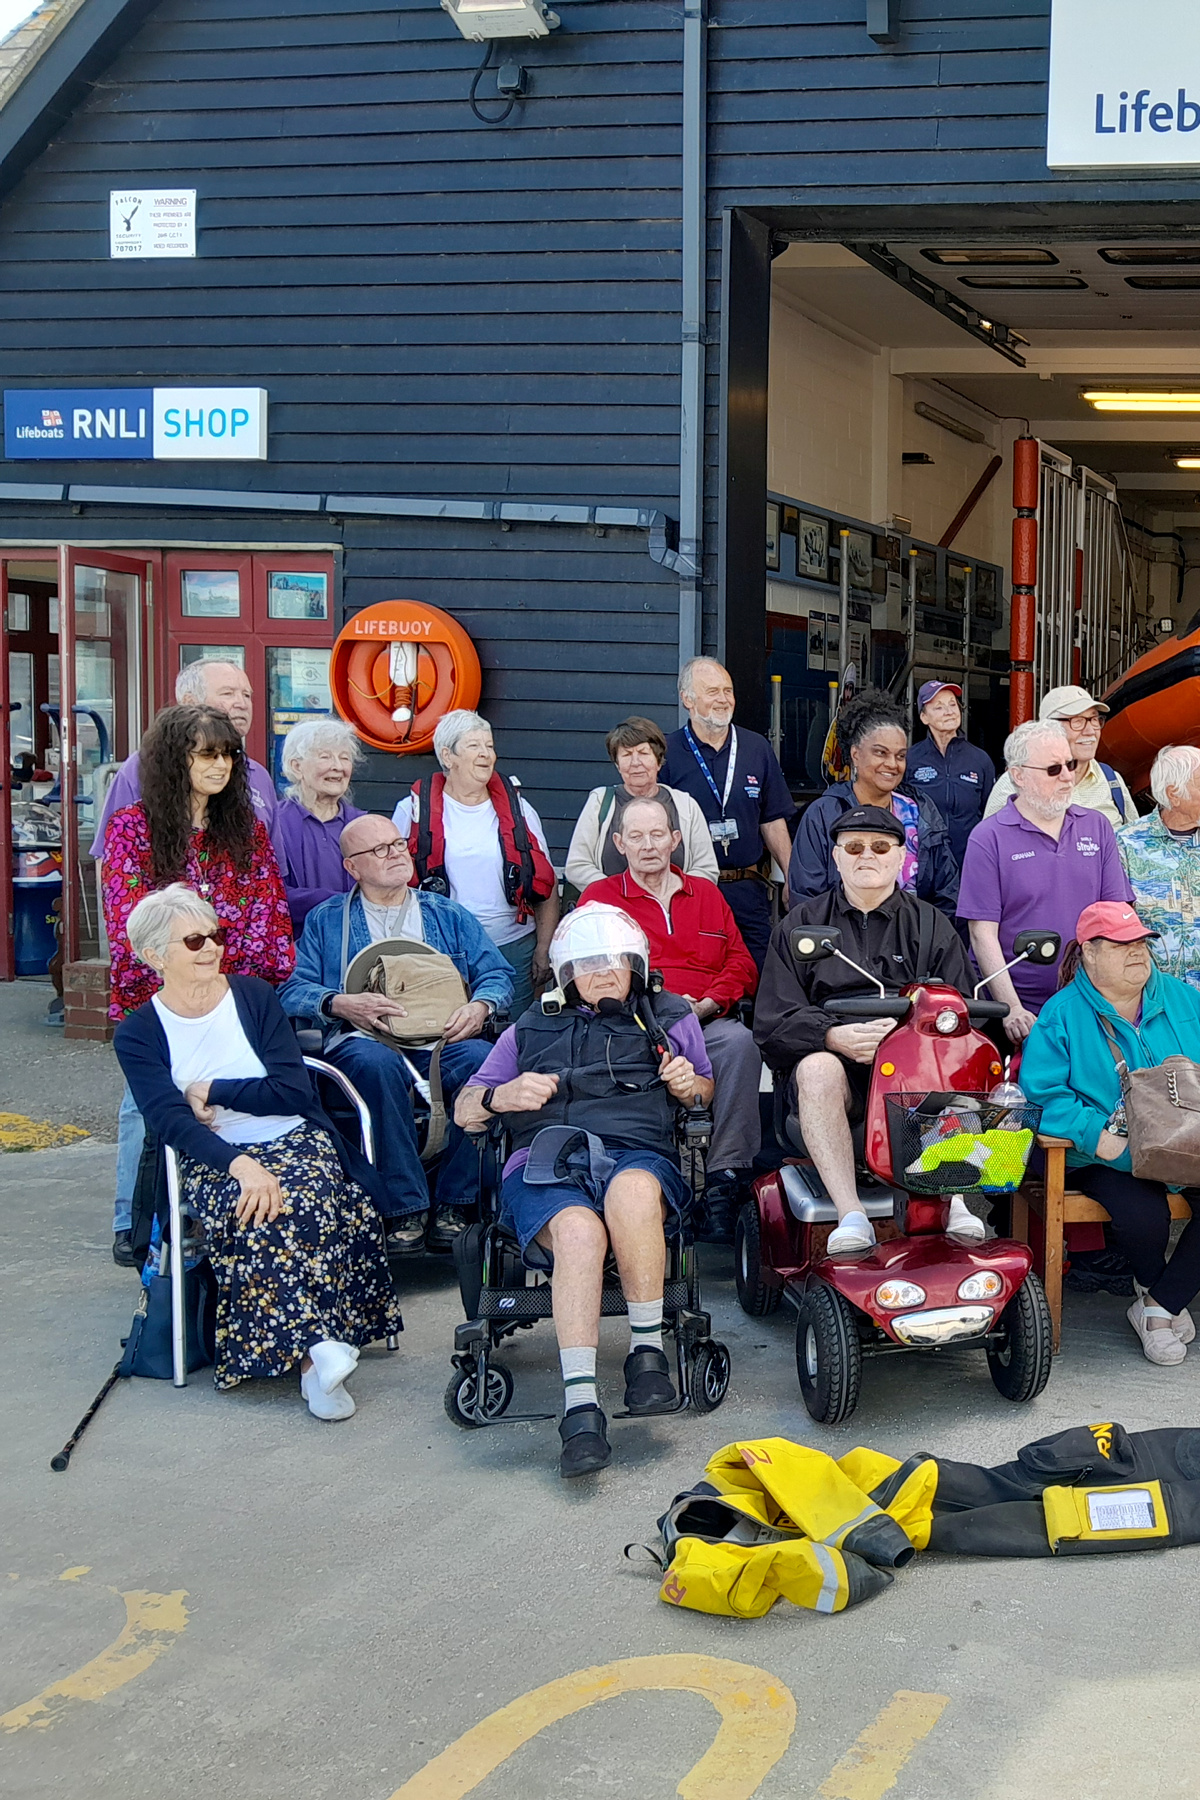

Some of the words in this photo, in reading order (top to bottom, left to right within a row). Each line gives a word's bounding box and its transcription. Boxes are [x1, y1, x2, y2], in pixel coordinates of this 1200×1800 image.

[153, 198, 188, 206] WARNING
[16, 427, 64, 439] Lifeboats
[73, 408, 146, 439] RNLI
[163, 408, 250, 438] SHOP
[354, 619, 433, 635] LIFEBUOY
[1011, 850, 1036, 861] GRAHAM
[1088, 1421, 1114, 1460] RN
